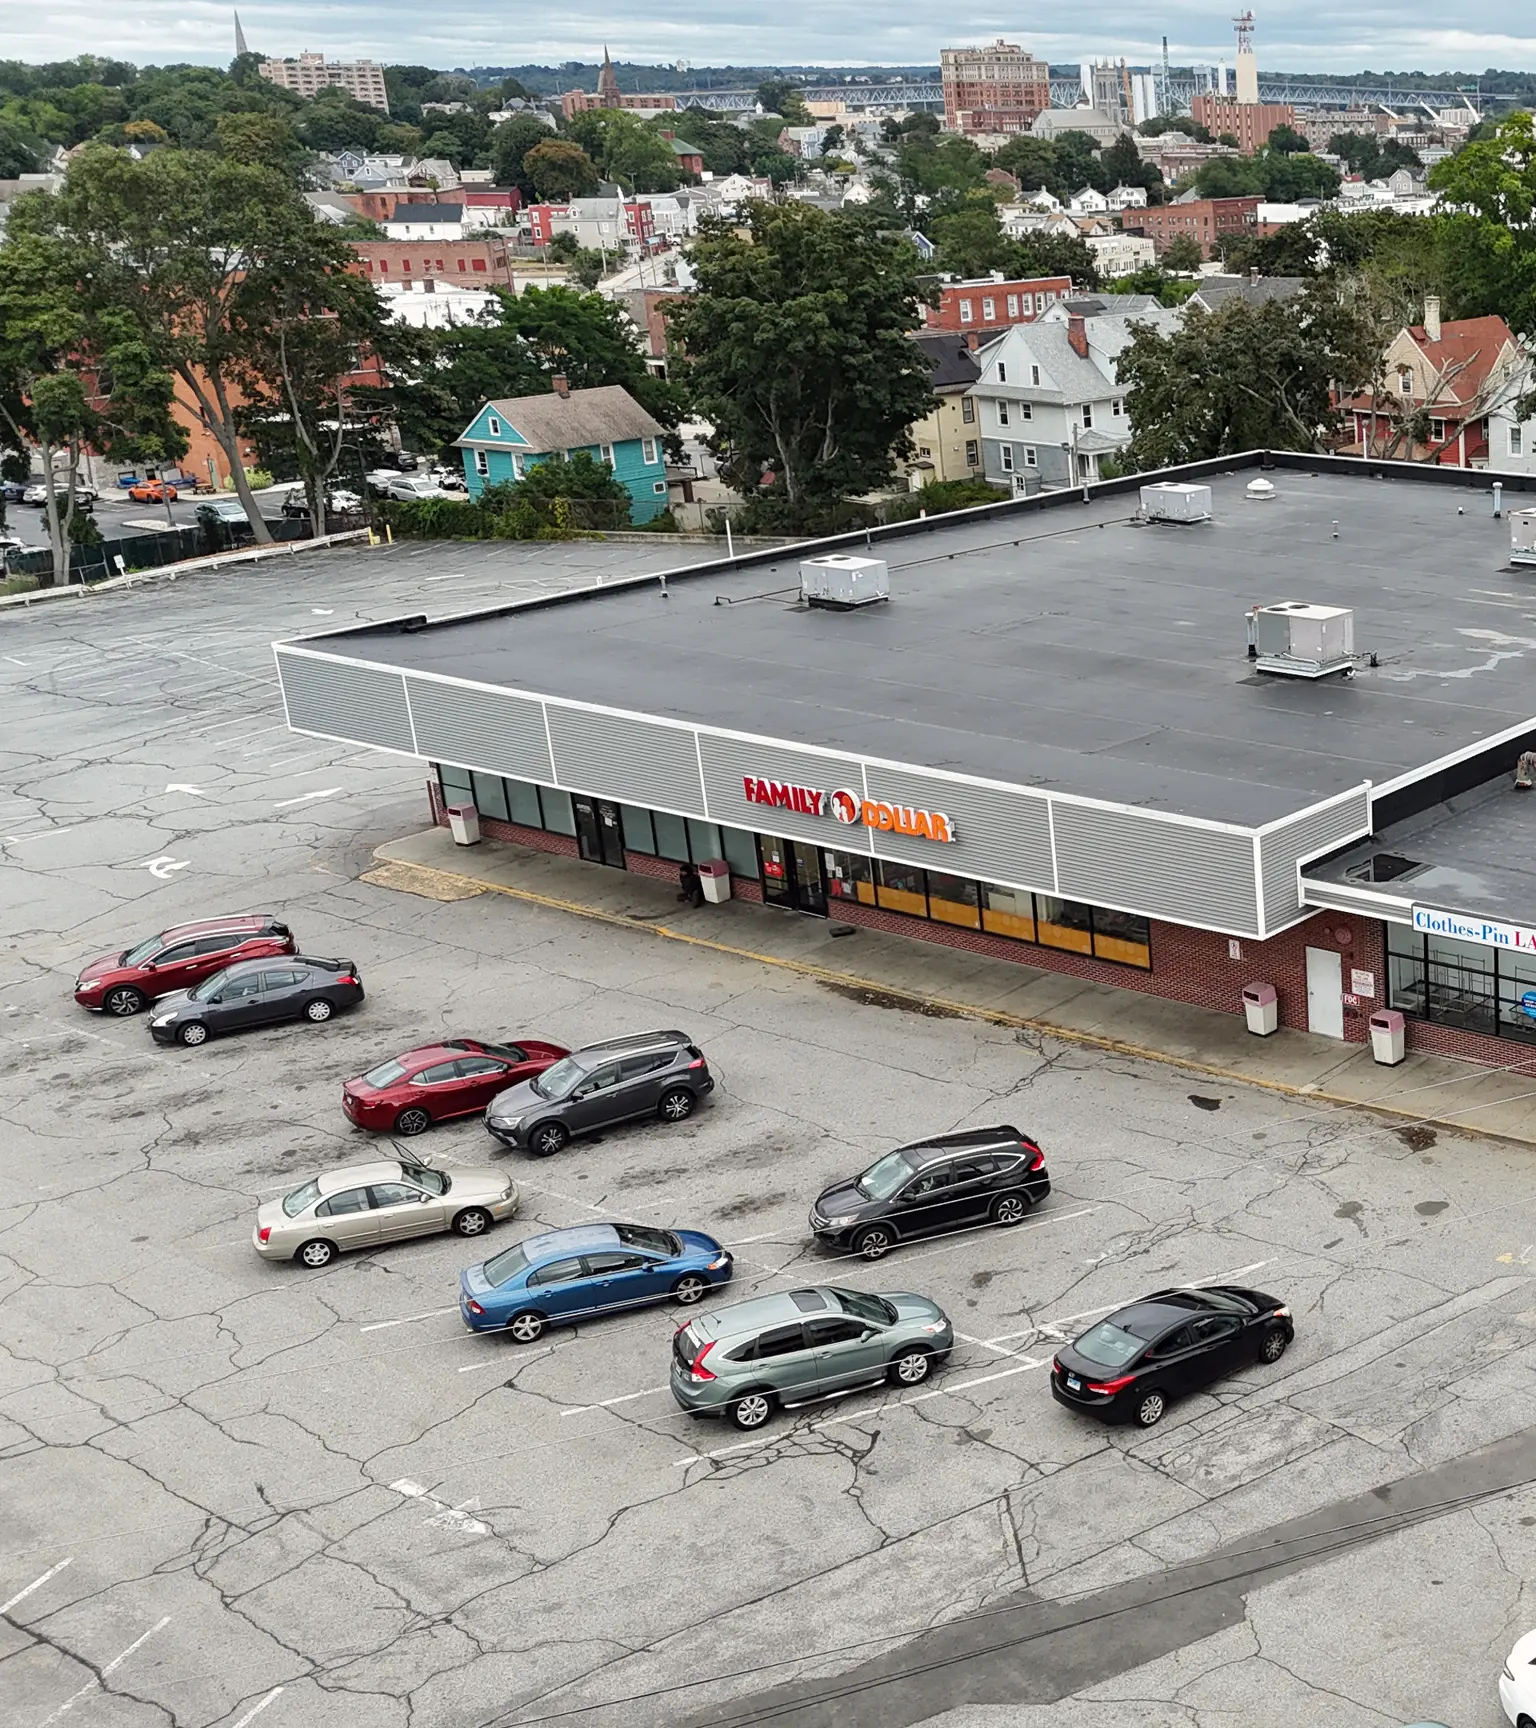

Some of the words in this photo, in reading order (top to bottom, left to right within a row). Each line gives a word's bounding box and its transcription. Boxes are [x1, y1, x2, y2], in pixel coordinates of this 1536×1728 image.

[743, 775, 825, 816] FAMILY
[861, 800, 953, 843] DOLLAR
[1416, 911, 1509, 945] Clothes-Pin
